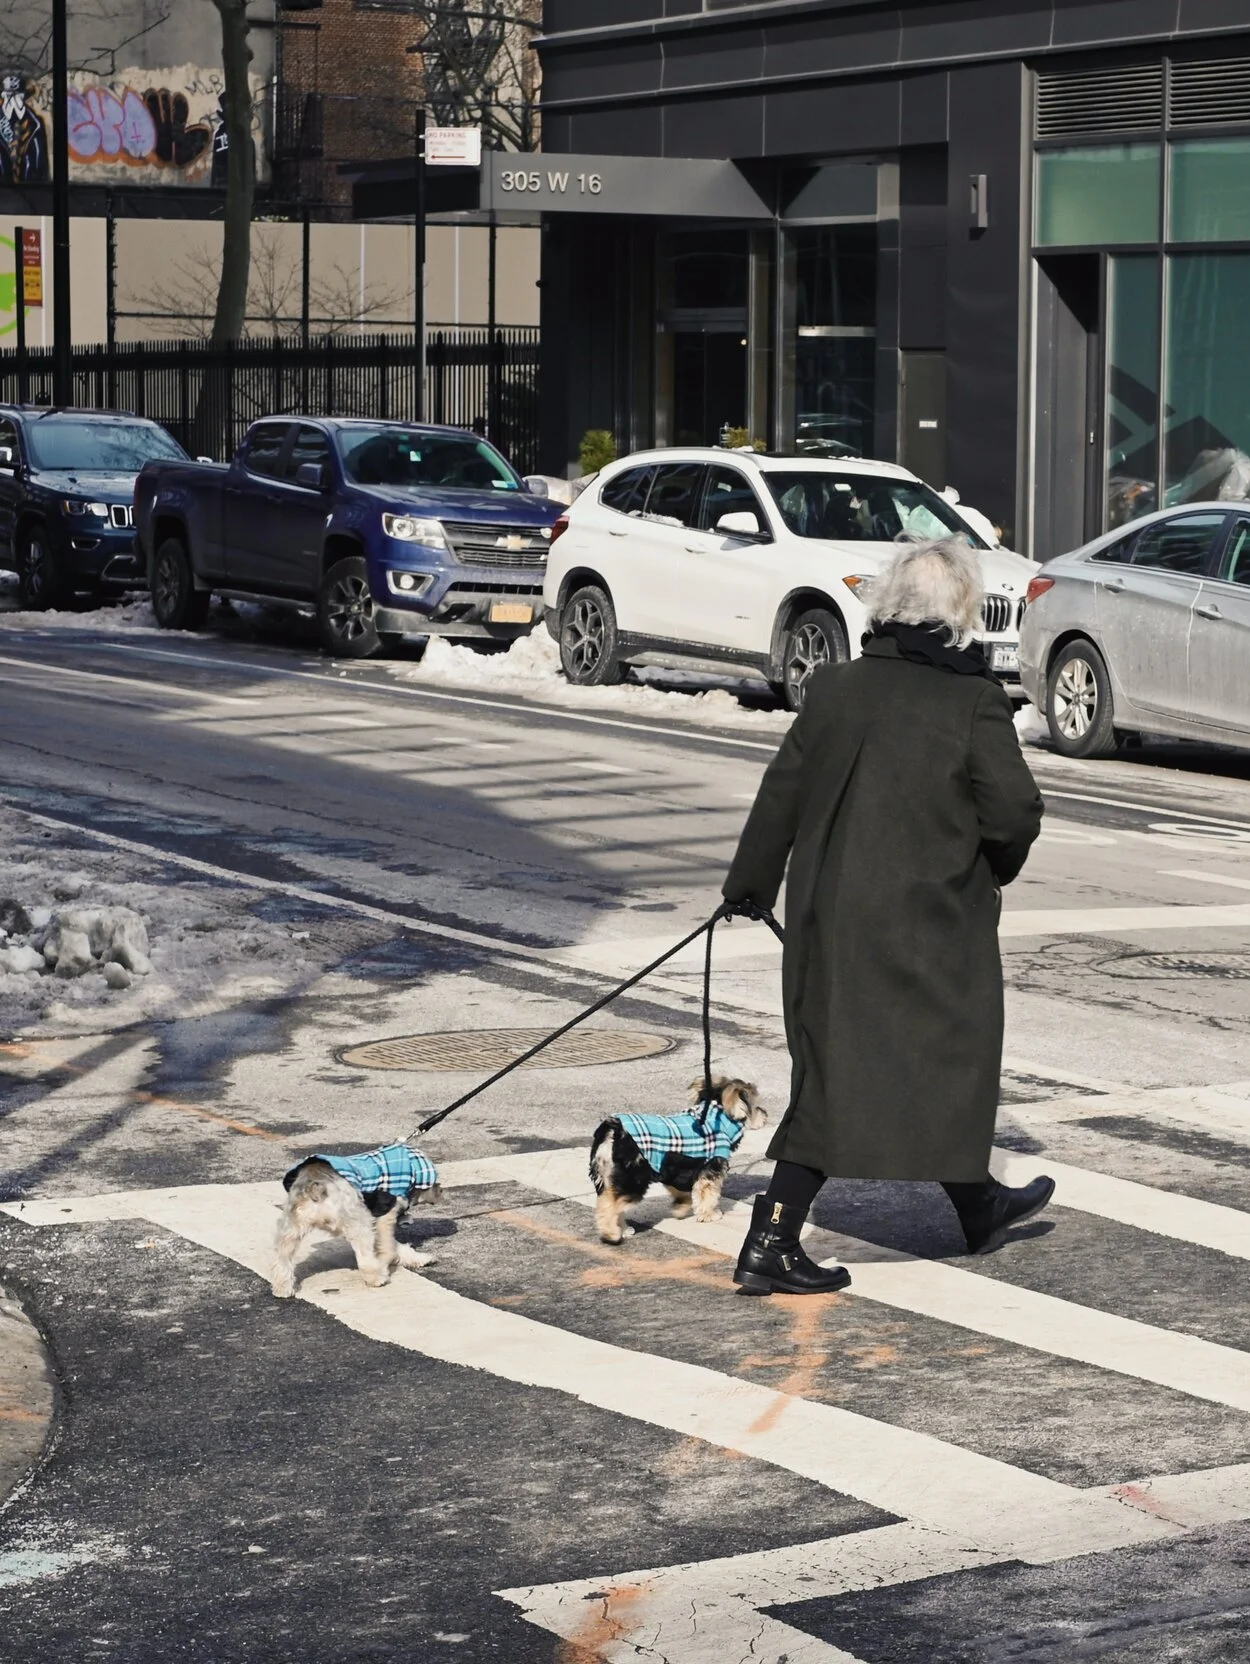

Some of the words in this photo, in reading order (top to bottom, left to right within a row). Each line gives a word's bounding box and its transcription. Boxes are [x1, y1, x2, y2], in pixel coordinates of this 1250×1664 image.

[501, 170, 541, 192] 305
[547, 171, 569, 192] W
[578, 173, 602, 194] 16
